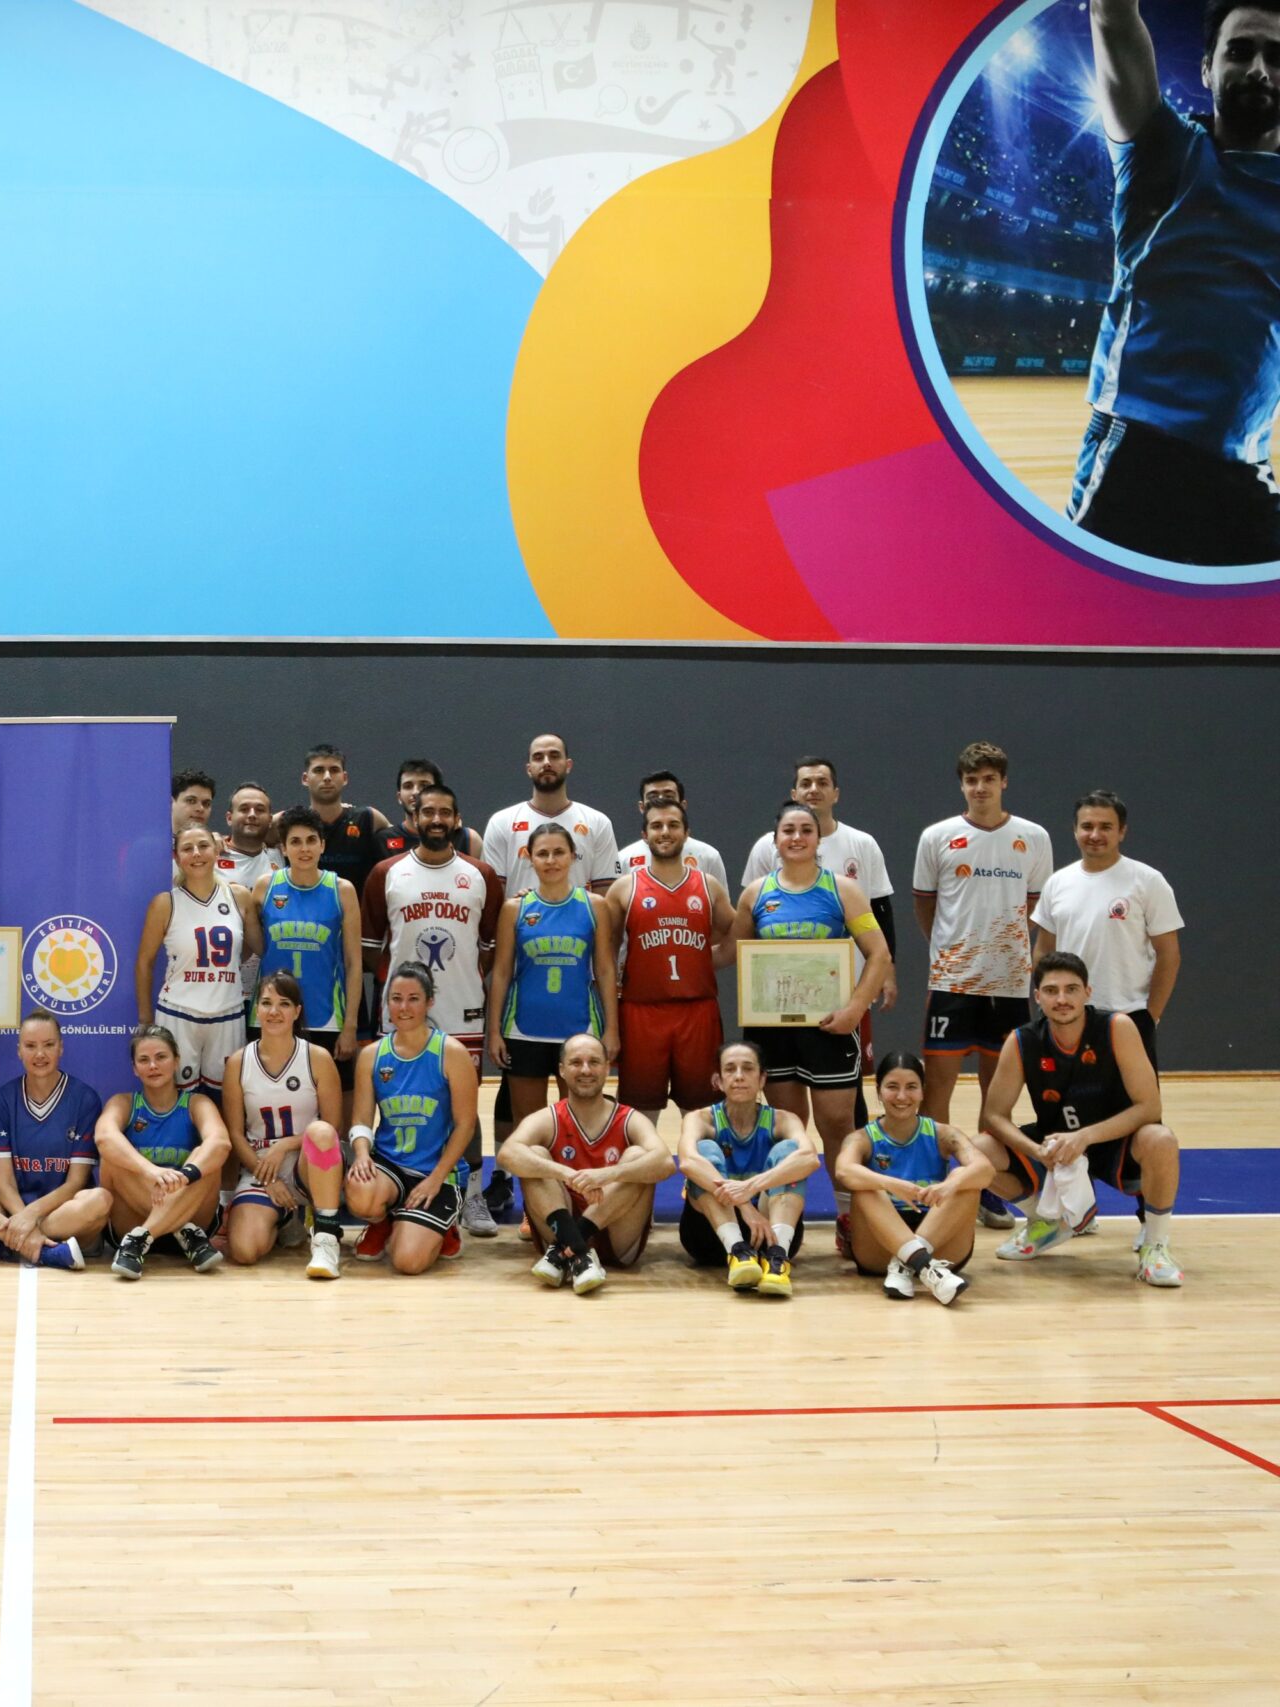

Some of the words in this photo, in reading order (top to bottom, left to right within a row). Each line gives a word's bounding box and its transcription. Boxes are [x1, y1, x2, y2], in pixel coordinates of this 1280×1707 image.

[268, 920, 331, 944] UNION
[194, 925, 234, 968] 19
[522, 935, 588, 959] UNION
[292, 950, 302, 978] 1
[668, 954, 680, 981] 1
[183, 971, 206, 983] RUN
[207, 972, 216, 982] &
[217, 971, 237, 984] FUN
[60, 1024, 126, 1035] GÖNÜLLÜLERİ
[930, 1016, 950, 1038] 17
[379, 1094, 439, 1118] UNION
[1062, 1105, 1081, 1130] 6
[259, 1105, 295, 1140] 11
[31, 1159, 43, 1172] &
